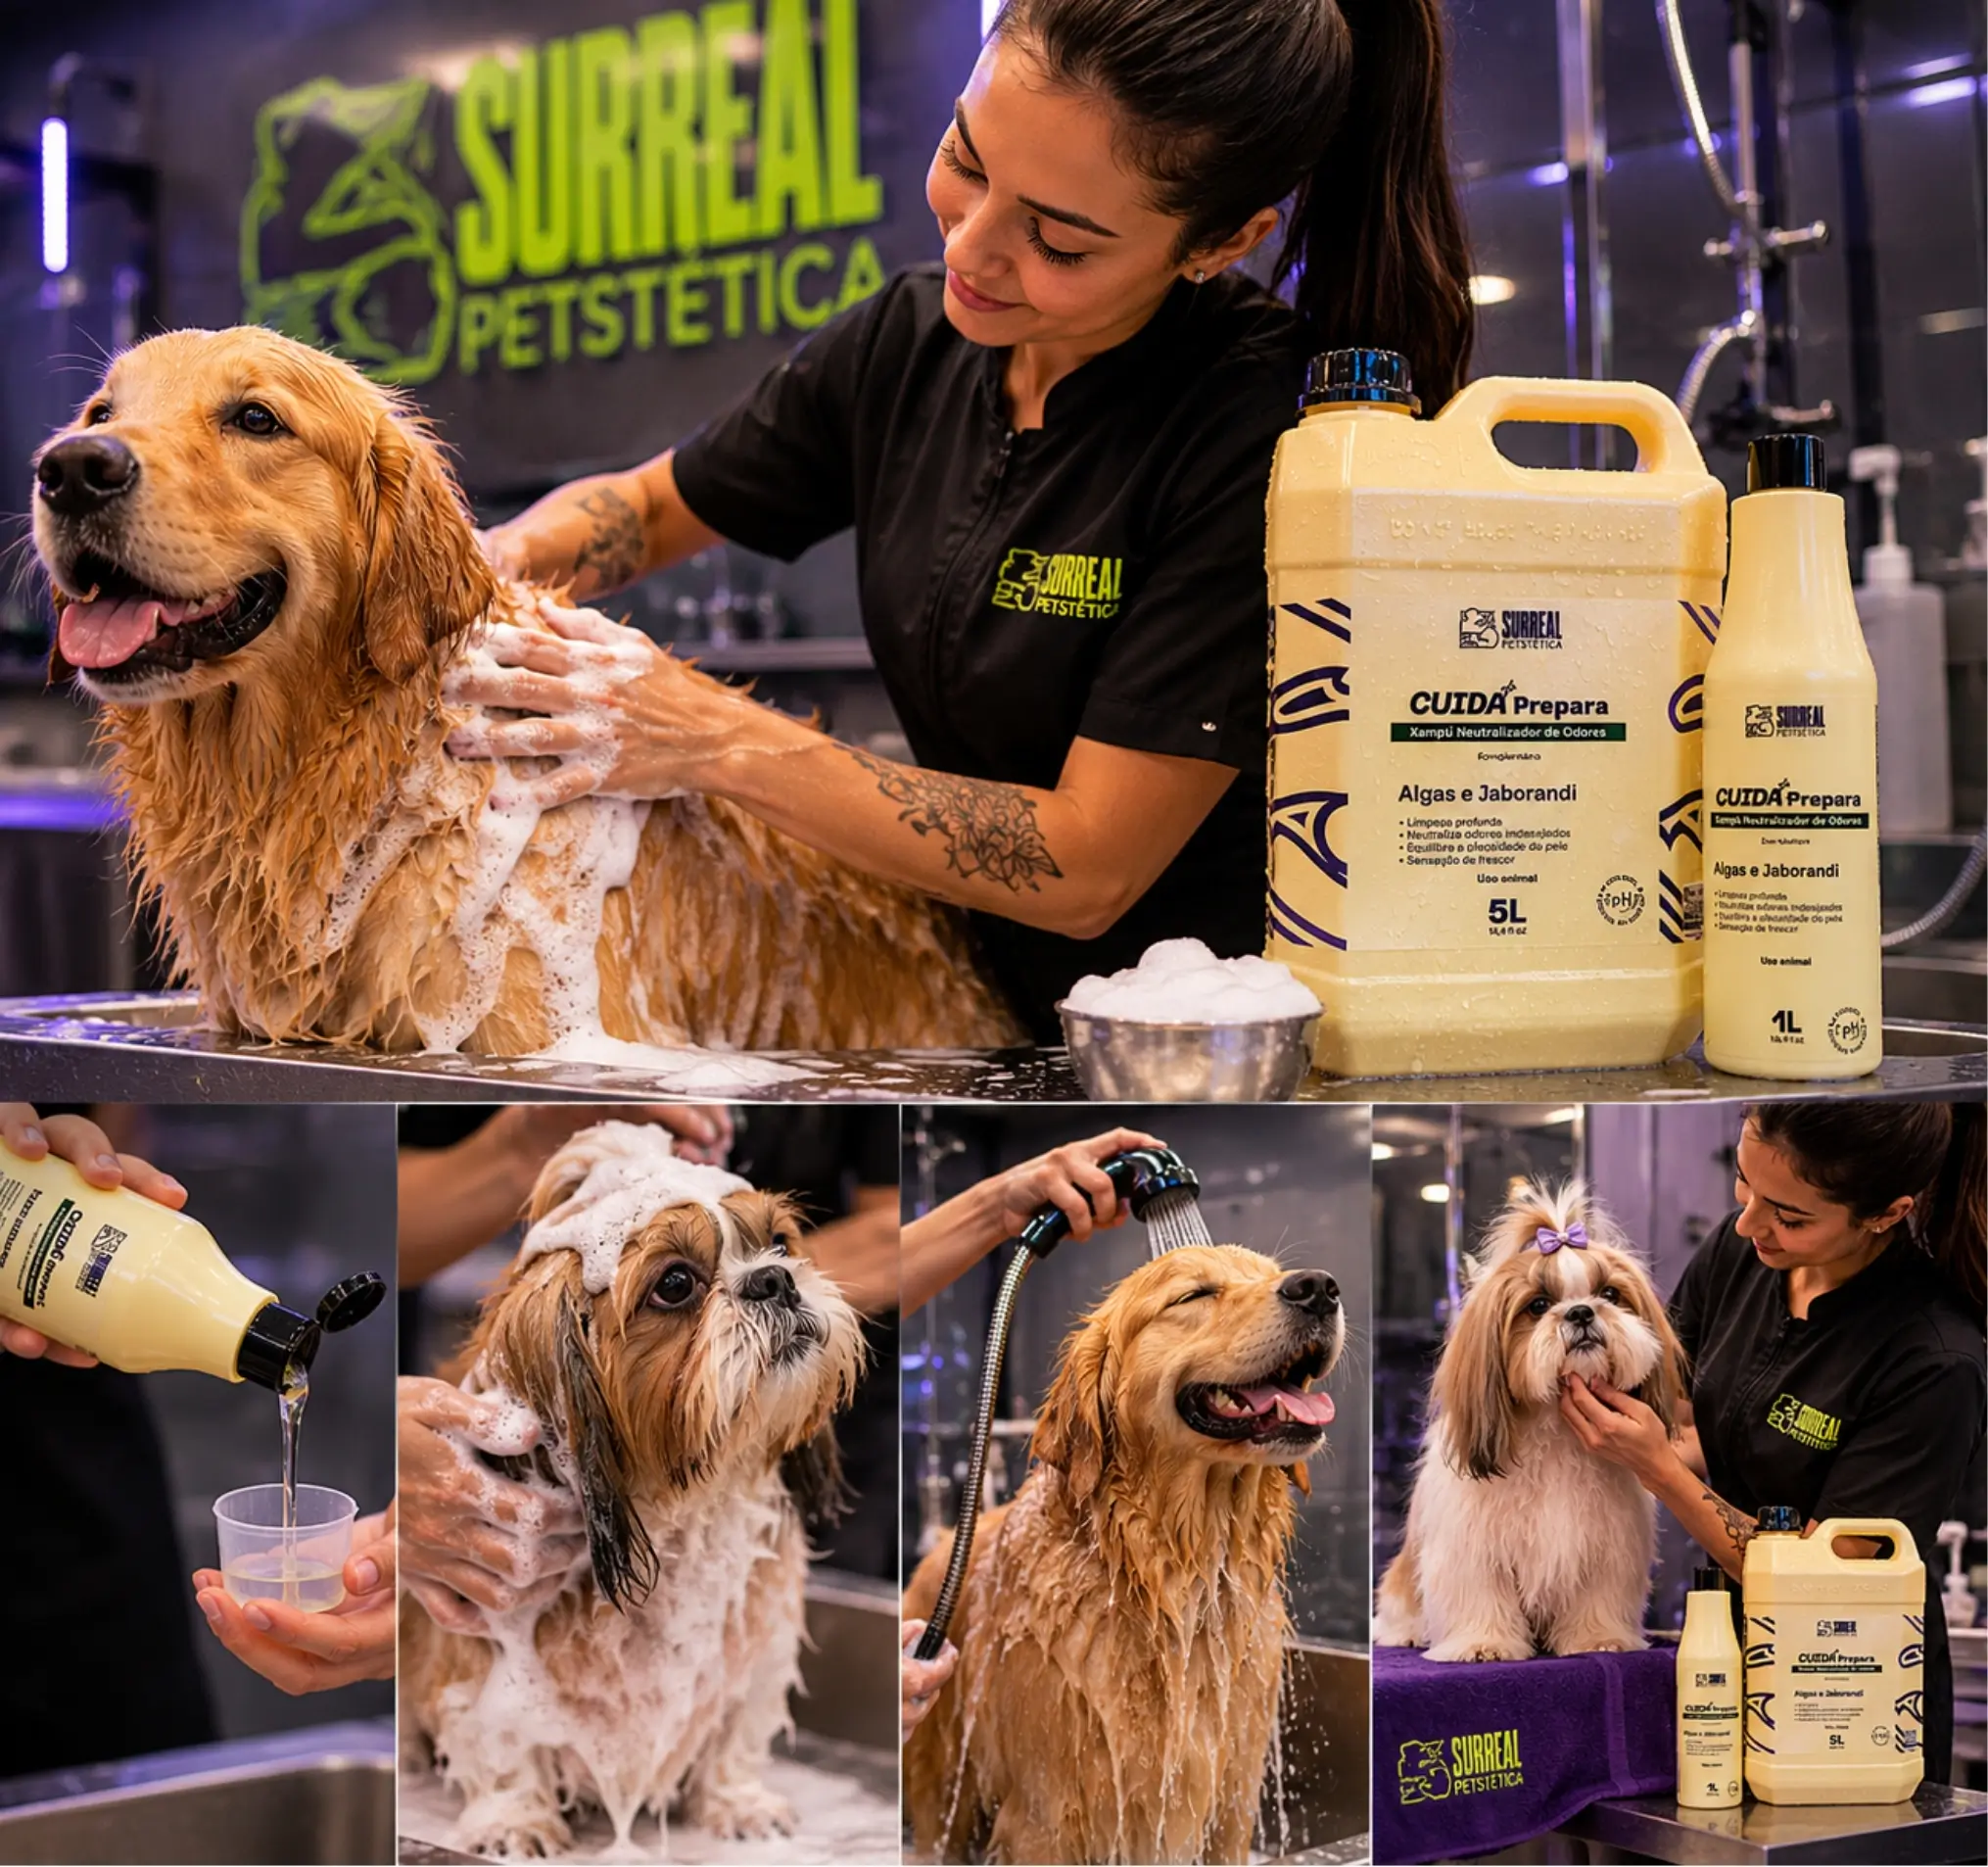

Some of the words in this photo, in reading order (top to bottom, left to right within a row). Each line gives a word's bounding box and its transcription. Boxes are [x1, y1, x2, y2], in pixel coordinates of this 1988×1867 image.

[453, 0, 883, 285] SURREAL
[457, 238, 884, 377] PETSTÉTICA
[1040, 553, 1123, 600] SURREAL
[1501, 610, 1563, 640] SURREAL
[1513, 696, 1609, 720] Prepara
[1456, 725, 1541, 738] Neutralizador
[1543, 725, 1561, 738] de
[1562, 725, 1607, 738] Odores
[1397, 785, 1456, 806] Algas
[1461, 790, 1474, 802] e
[1478, 784, 1578, 802] Jaborandi
[1786, 791, 1862, 810] Prepara
[1713, 861, 1746, 879] Algas
[1749, 867, 1759, 877] e
[1762, 864, 1840, 878] Jaborandi
[1488, 898, 1528, 925] 5L
[1772, 1010, 1803, 1033] 1L
[1451, 1729, 1523, 1778] SURREAL
